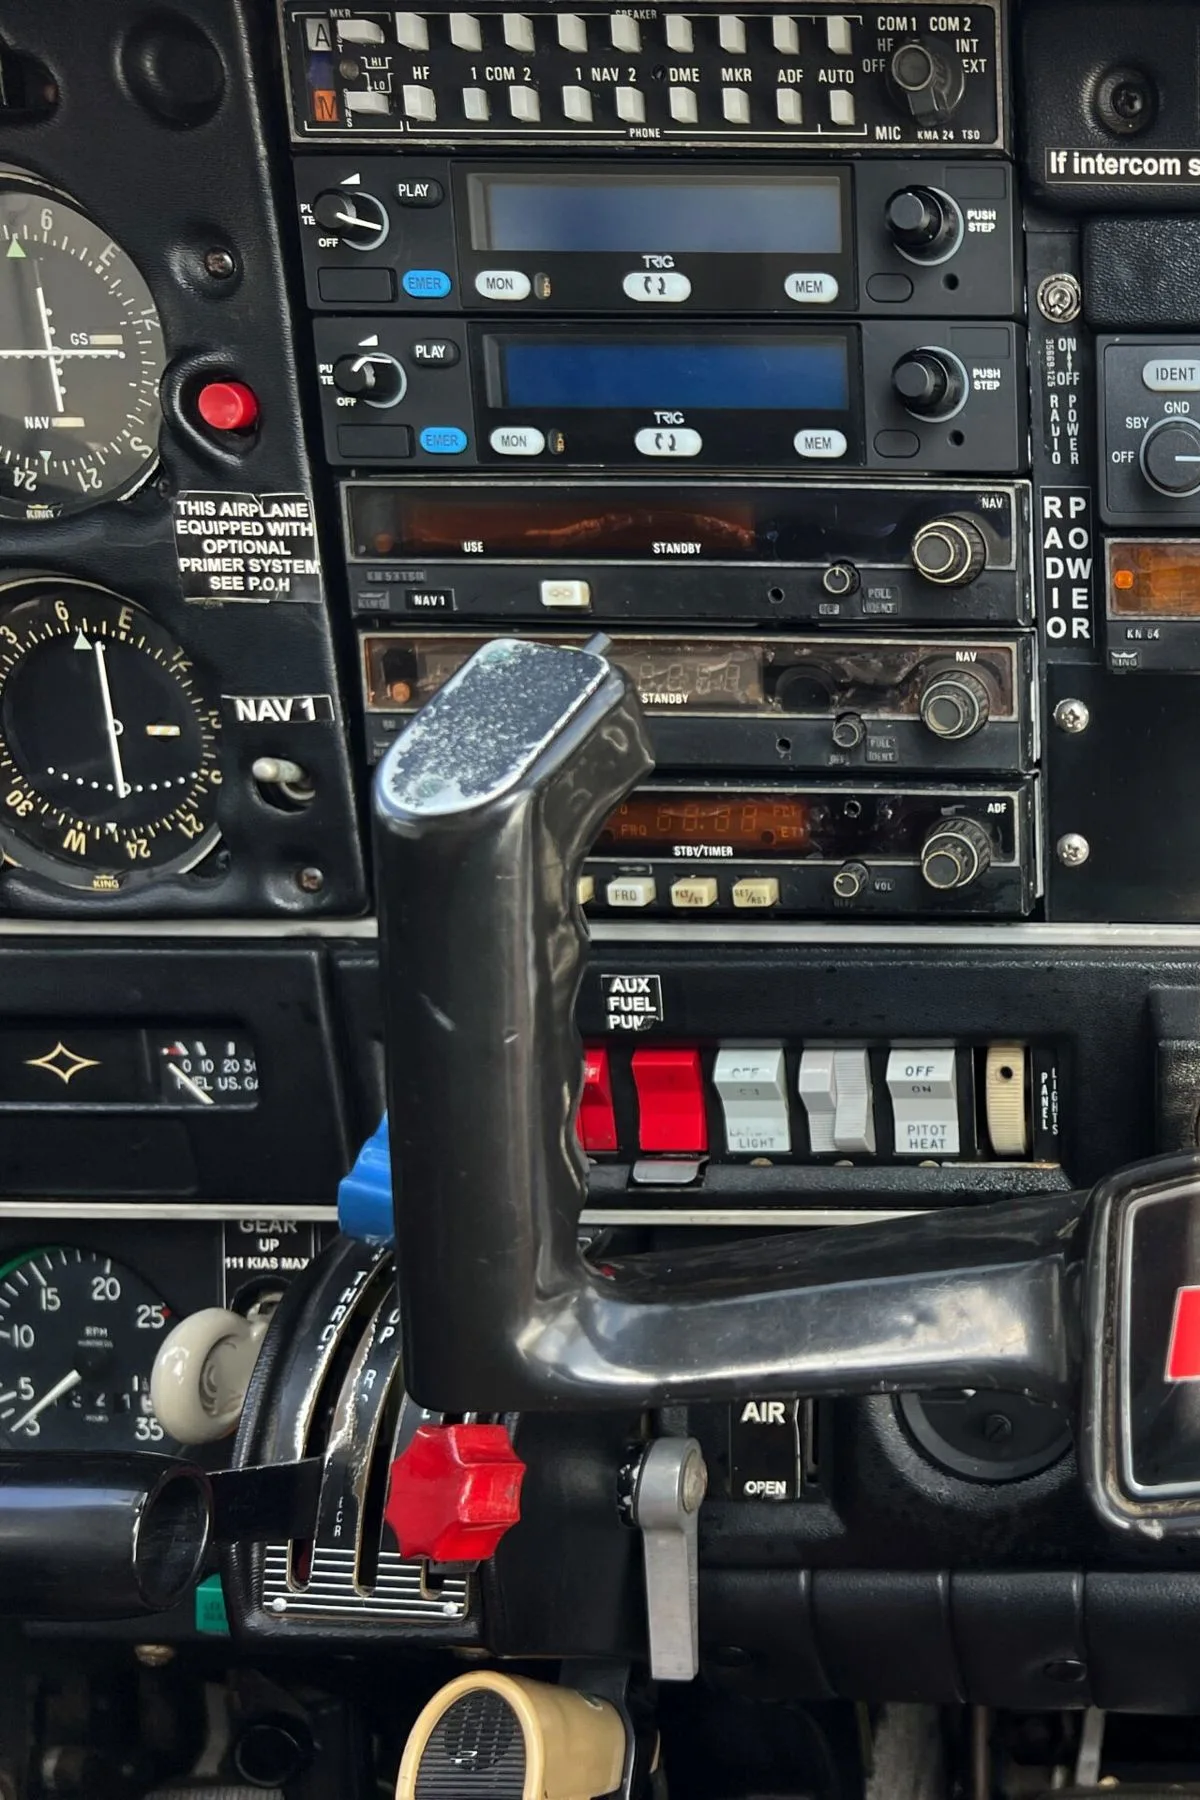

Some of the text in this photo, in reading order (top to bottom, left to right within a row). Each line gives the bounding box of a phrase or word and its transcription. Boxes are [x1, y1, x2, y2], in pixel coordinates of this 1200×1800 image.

[930, 18, 971, 32] COM 2
[878, 38, 893, 52] HF
[956, 39, 979, 52] INT
[862, 59, 886, 73] OFF
[962, 59, 987, 73] EXT
[413, 67, 430, 79] HF
[471, 68, 532, 81] 1 COM 2
[576, 68, 637, 81] 1 NAV 2
[669, 69, 699, 82] DME
[722, 69, 752, 82] MKR
[778, 69, 803, 83] ADF
[818, 69, 854, 83] AUTO
[629, 128, 661, 138] PHONE
[876, 127, 900, 140] MIC
[918, 130, 953, 140] KMA 24
[1050, 152, 1067, 174] If
[1073, 153, 1182, 177] intercom
[398, 184, 429, 197] PLAY
[967, 209, 996, 221] PUSH
[968, 222, 995, 232] STEP
[318, 238, 338, 248] OFF
[408, 277, 441, 290] EMER
[486, 278, 513, 290] MON
[795, 280, 823, 293] MEM
[70, 333, 88, 345] GS
[1058, 338, 1076, 351] ON
[415, 345, 446, 358] PLAY
[972, 368, 1000, 379] PUSH
[1057, 372, 1079, 385] OFF
[1156, 368, 1195, 381] IDENT
[973, 380, 1000, 390] STEP
[337, 398, 356, 406] OFF
[1164, 402, 1190, 413] GND
[24, 416, 49, 429] NAV
[1125, 417, 1149, 429] SBY
[1067, 395, 1079, 465] POWER
[426, 434, 459, 446] EMER
[501, 435, 527, 447] MON
[804, 437, 832, 449] MEM
[1112, 451, 1134, 463] OFF
[177, 501, 308, 517] THIS AIRPLANE
[982, 497, 1003, 509] NAV
[176, 520, 314, 537] EQUIPPED WITH
[203, 539, 291, 555] OPTIONAL
[464, 541, 484, 552] USE
[653, 543, 701, 554] STANDBY
[179, 558, 320, 574] PRIMER SYSTEM
[1043, 497, 1067, 639] RADIO
[1067, 496, 1092, 639] POWER
[210, 576, 290, 591] SEE P.O.H
[955, 652, 977, 662] NAV
[641, 694, 689, 704] STANDBY
[234, 698, 316, 721] NAV 1
[987, 804, 1007, 814] ADF
[674, 845, 733, 857] STBY/TIMER
[93, 879, 119, 889] KING
[614, 890, 637, 901] FRQ
[612, 978, 650, 993] AUX
[608, 997, 656, 1012] FUEL
[905, 1066, 935, 1077] OFF
[907, 1125, 947, 1136] PITOT
[739, 1138, 775, 1148] LIGHT
[909, 1138, 946, 1149] HEAT
[240, 1220, 298, 1233] GEAR
[259, 1239, 279, 1251] UP
[92, 1277, 121, 1300] 20
[41, 1287, 61, 1311] 15
[136, 1305, 165, 1328] 25
[12, 1324, 34, 1348] 10
[85, 1326, 108, 1337] RPM
[742, 1402, 786, 1424] AIR
[134, 1418, 164, 1440] 35
[744, 1481, 786, 1494] OPEN
